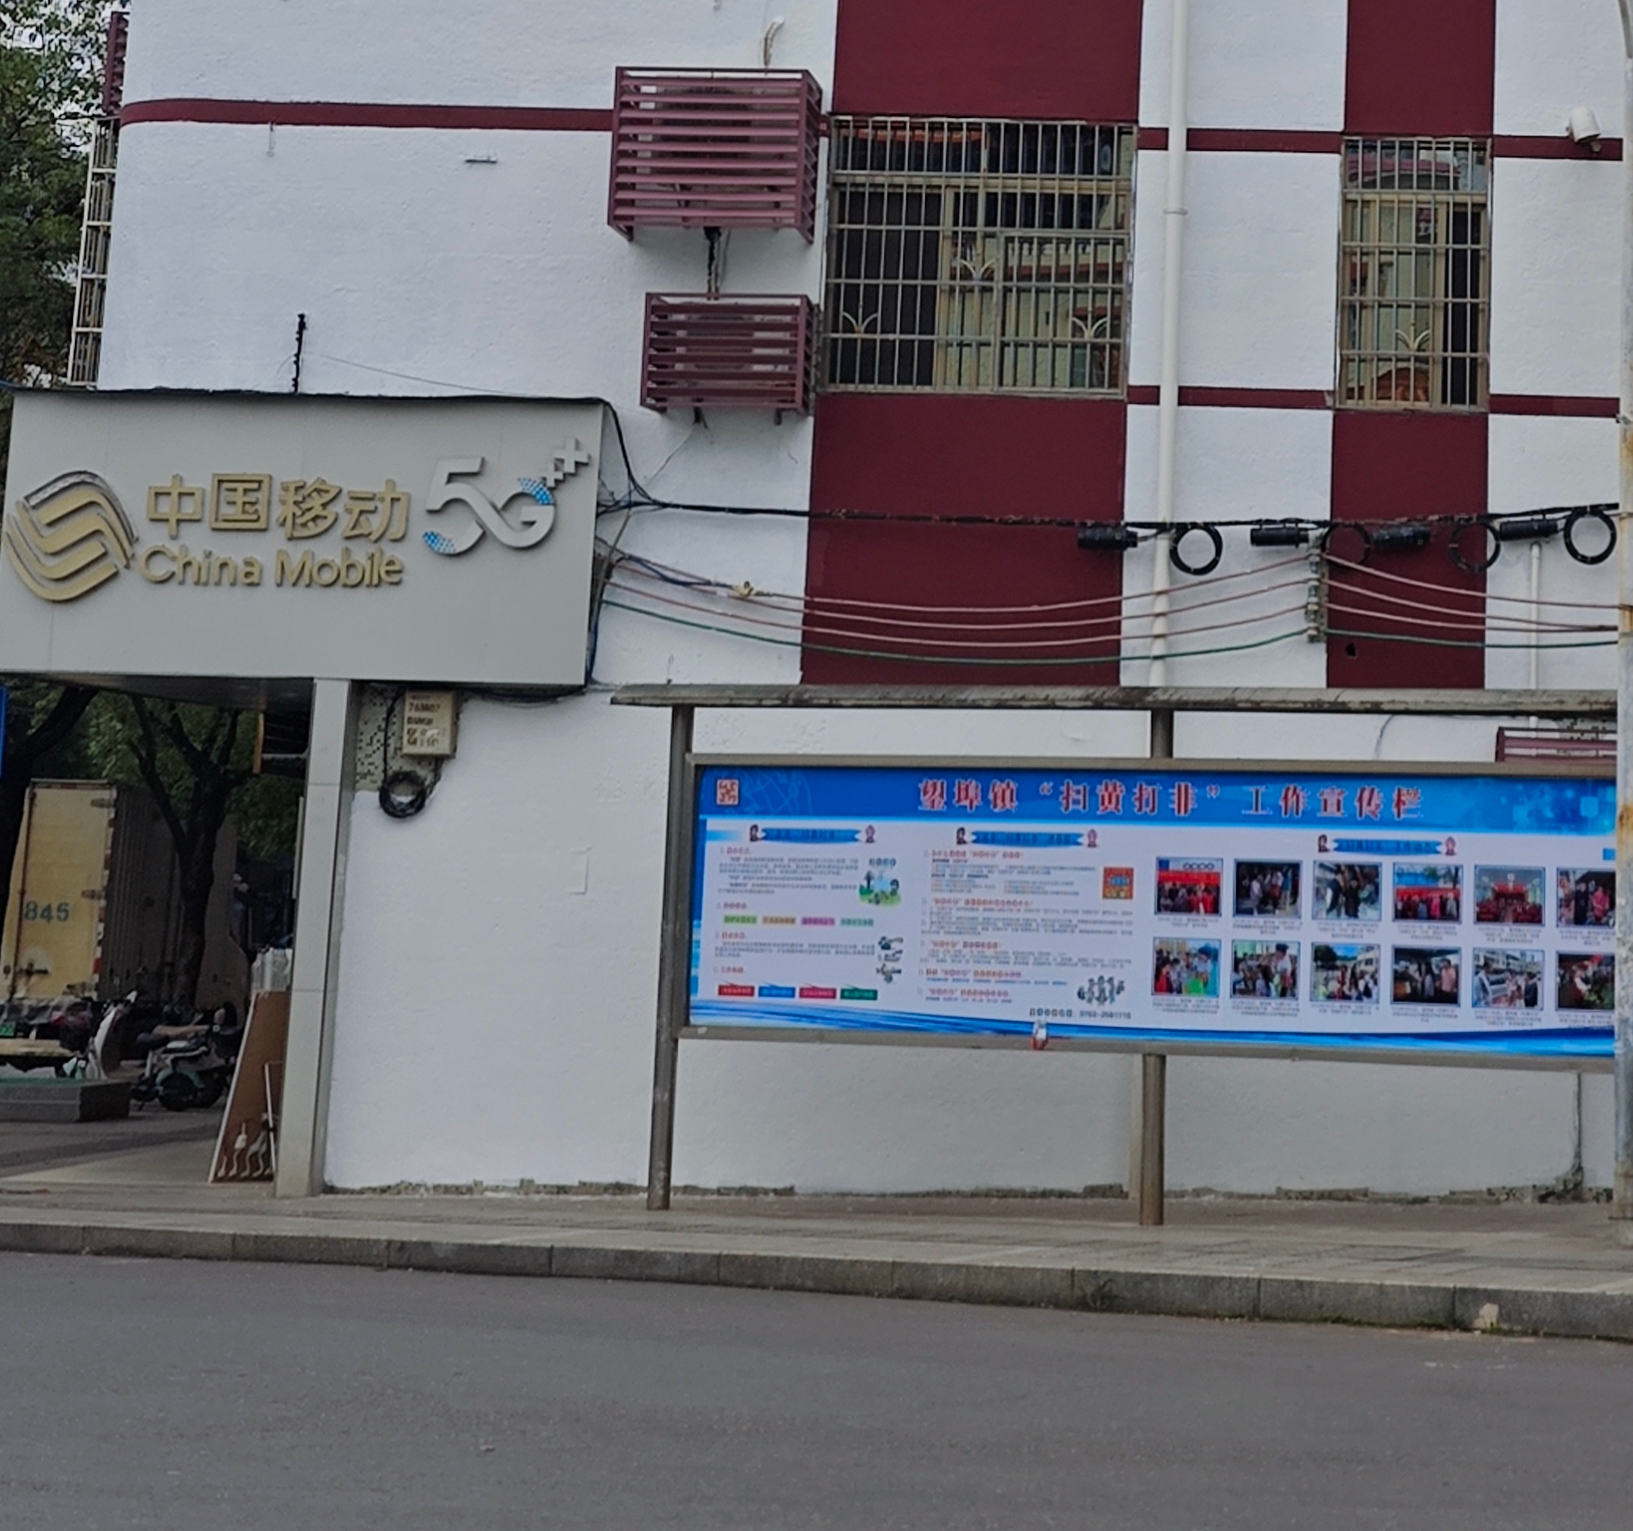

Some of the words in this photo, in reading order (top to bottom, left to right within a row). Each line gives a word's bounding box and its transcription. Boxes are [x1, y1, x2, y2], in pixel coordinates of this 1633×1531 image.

[146, 473, 412, 543] 中国移动
[138, 544, 262, 588] China
[274, 548, 406, 588] Mobile
